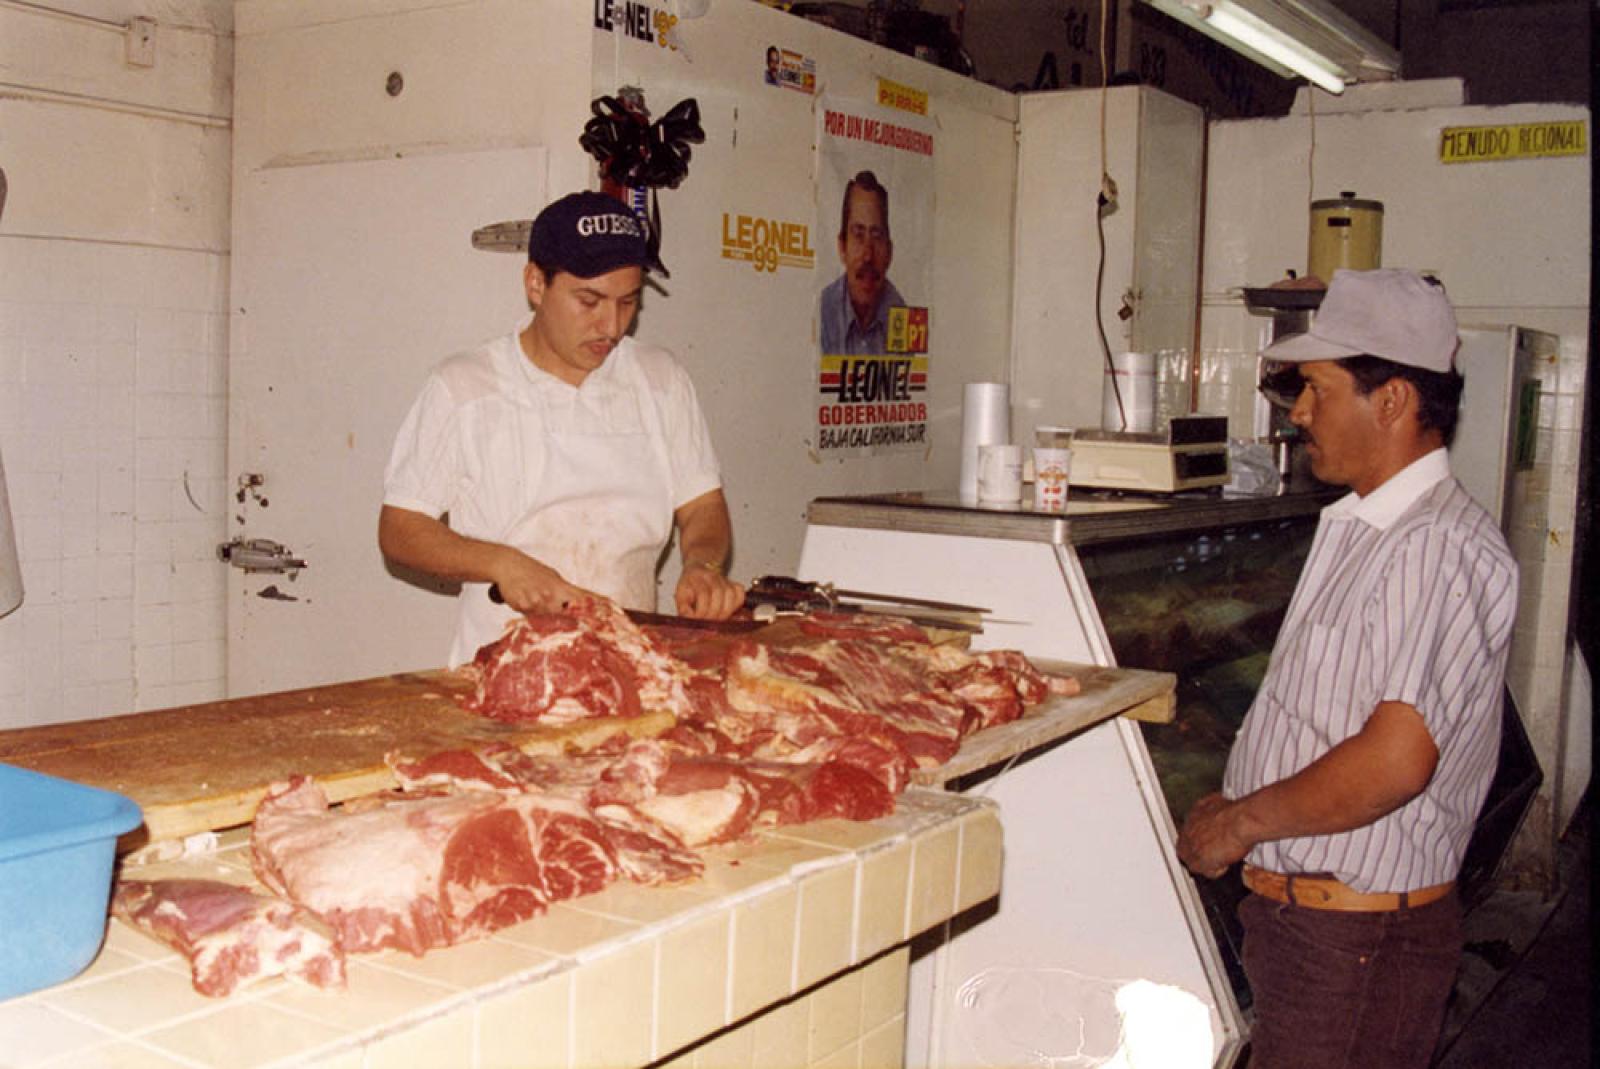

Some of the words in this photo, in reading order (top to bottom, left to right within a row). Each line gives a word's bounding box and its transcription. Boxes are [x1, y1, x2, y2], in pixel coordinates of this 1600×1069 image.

[824, 110, 845, 137] POR
[847, 115, 863, 141] UN
[1441, 127, 1511, 158] MENUDO
[722, 213, 815, 257] LEONEL
[753, 244, 778, 272] 99
[838, 359, 911, 403] LEONEL
[819, 402, 927, 426] GOBERNADOR
[819, 428, 848, 449] BAJA
[850, 425, 906, 446] CALIFORNIA
[907, 423, 926, 443] SUR
